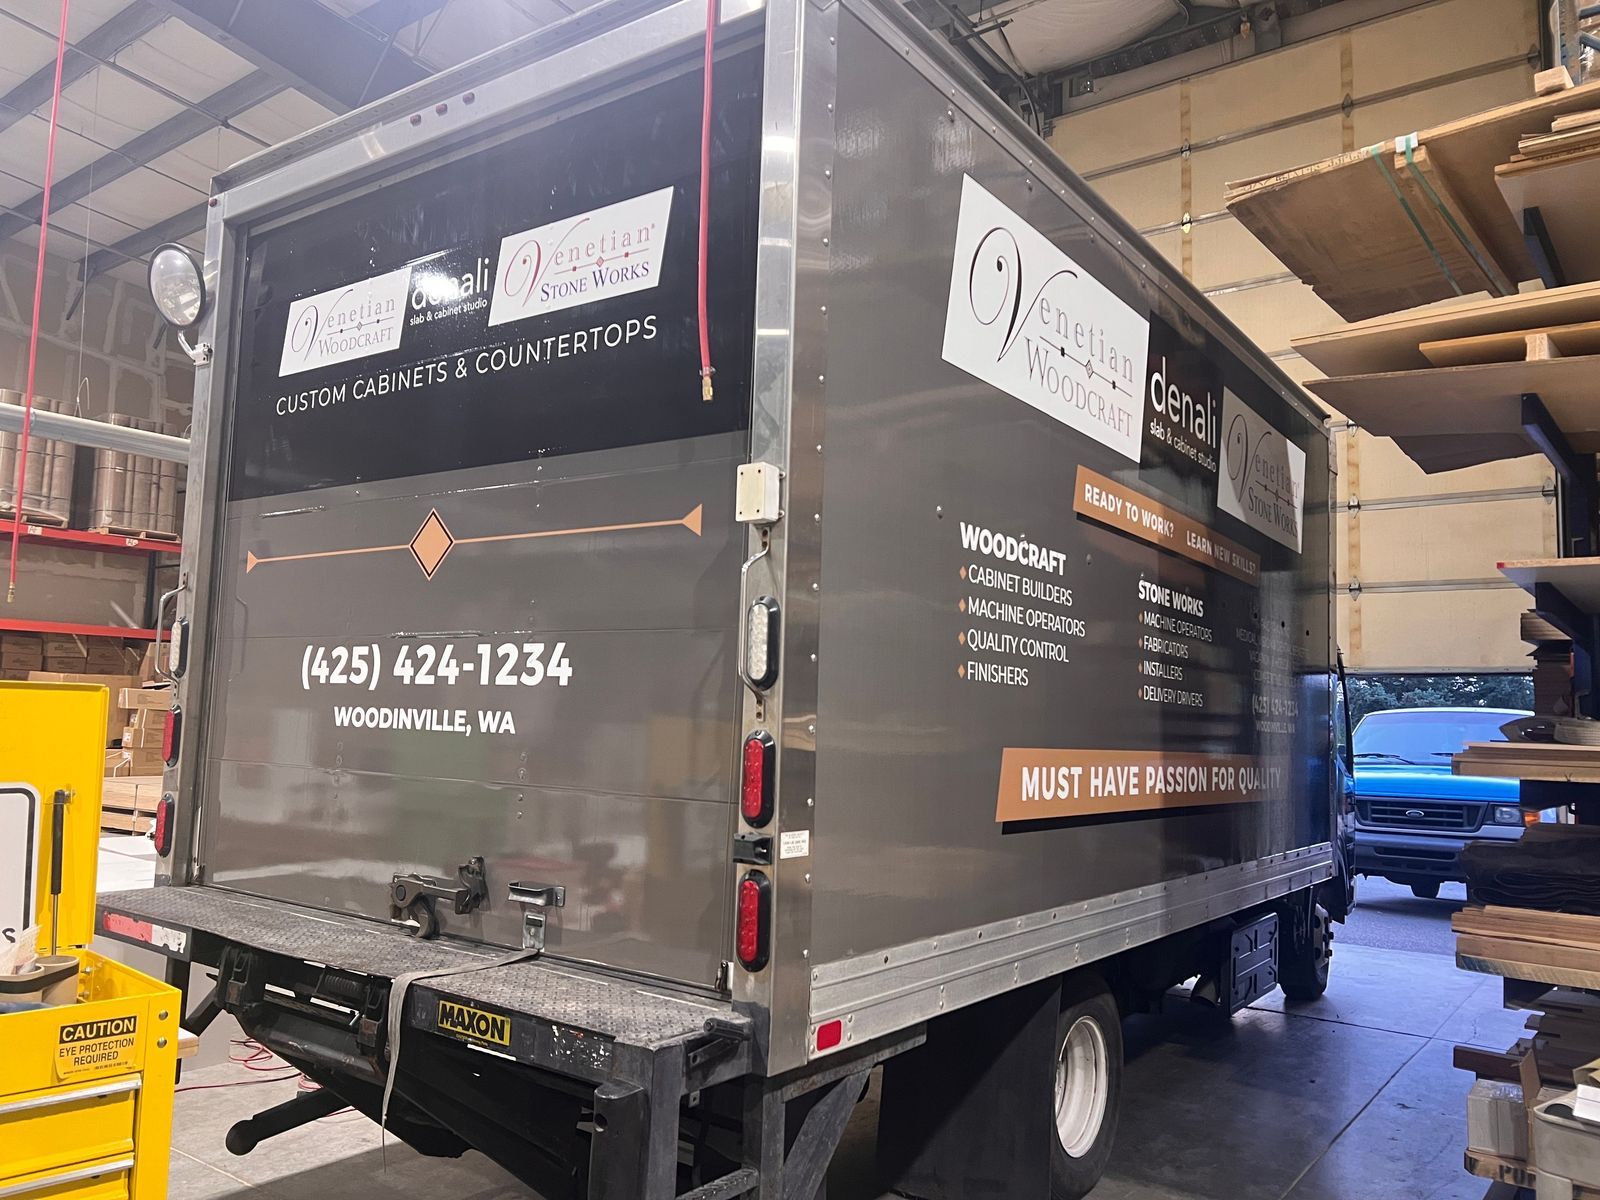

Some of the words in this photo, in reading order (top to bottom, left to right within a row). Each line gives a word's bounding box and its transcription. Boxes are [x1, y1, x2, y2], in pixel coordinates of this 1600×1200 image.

[504, 217, 650, 308] Venetian
[291, 288, 395, 362] Venetian
[409, 312, 425, 326] slab
[426, 310, 433, 322] &
[434, 303, 462, 320] cabinet
[463, 297, 488, 313] studio
[969, 227, 1134, 384] Venetian
[276, 383, 347, 416] CUSTOM
[352, 361, 448, 400] CABINETS
[454, 357, 468, 379] &
[475, 315, 657, 374] COUNTERTOPS
[1150, 355, 1216, 449] denali
[1149, 417, 1165, 441] slab
[1166, 427, 1174, 446] &
[1173, 432, 1198, 462] cabinet
[1198, 447, 1217, 473] studio
[1227, 414, 1298, 503] Venetian
[959, 521, 1067, 576] WOODCRAFT
[1084, 483, 1122, 516] READY
[1125, 501, 1139, 523] TO
[1141, 508, 1175, 538] WORK?
[1186, 530, 1213, 556] LEARN
[1214, 543, 1230, 564] NEW
[1232, 552, 1256, 576] SKILLS?
[968, 563, 1021, 593] CABINET
[1022, 577, 1073, 607] BUILDERS
[1138, 579, 1171, 607] STONE
[1171, 590, 1204, 618] WORKS
[968, 596, 1024, 625] MACHINE
[1025, 608, 1086, 638] OPERATORS
[1143, 610, 1176, 633] MACHINE
[1176, 619, 1213, 642] OPERATORS
[967, 628, 1019, 655] QUALITY
[1020, 637, 1070, 663] CONTROL
[1143, 635, 1189, 659] FABRICATORS
[301, 643, 381, 690] (425)
[393, 642, 573, 686] 424-1234
[967, 660, 1029, 687] FINISHERS
[1143, 660, 1183, 681] INSTALLERS
[1143, 684, 1177, 703] DELIVERY
[1177, 690, 1204, 707] DRIVERS
[333, 706, 472, 737] WOODINVILLE,
[477, 710, 516, 735] WA
[1021, 766, 1083, 802] MUST
[1090, 766, 1140, 798] HAVE
[1145, 766, 1208, 795] PASSION
[1211, 766, 1235, 792] FOR
[1238, 767, 1281, 795] QUALITY
[62, 1018, 135, 1042] CAUTION
[440, 1003, 505, 1042] MAXON
[59, 1046, 77, 1058] EYE
[79, 1037, 135, 1055] PROTECTION
[73, 1050, 119, 1067] REQUIRED
